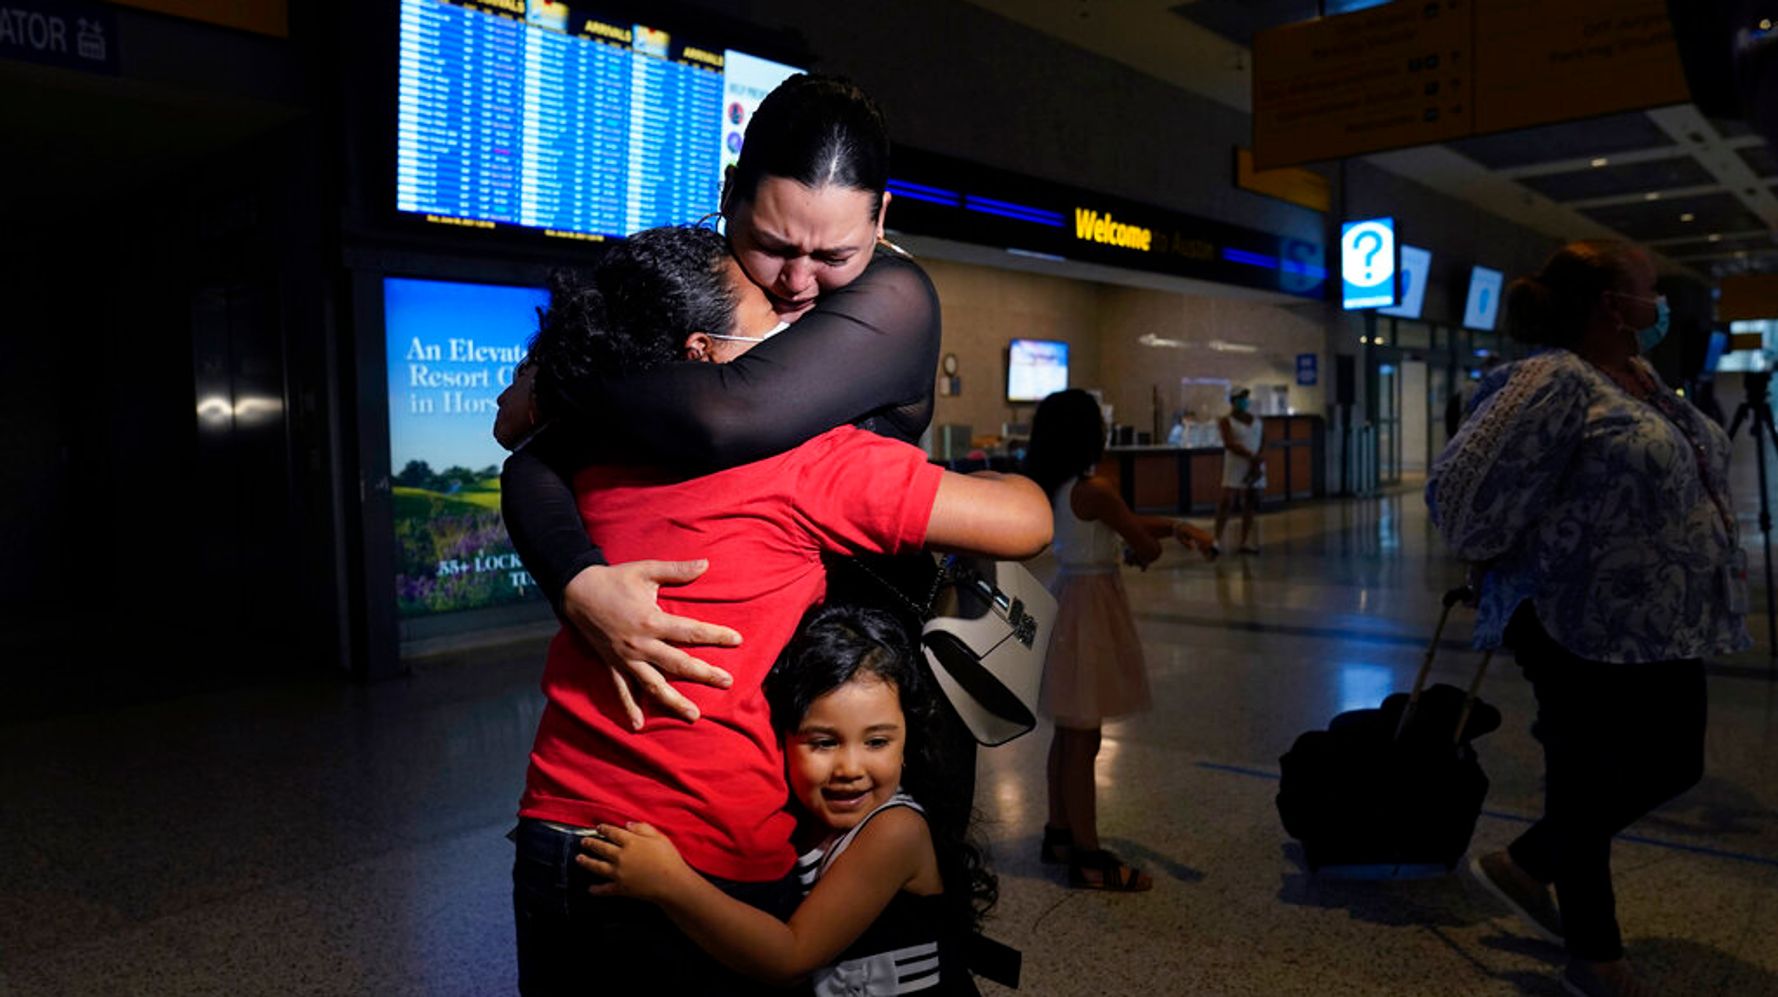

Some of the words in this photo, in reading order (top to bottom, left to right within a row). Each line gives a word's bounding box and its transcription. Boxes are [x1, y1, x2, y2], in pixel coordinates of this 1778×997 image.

[0, 7, 67, 53] ATOR
[1075, 206, 1152, 251] Welcome
[406, 336, 442, 361] An
[410, 363, 490, 388] Resort
[411, 393, 434, 413] in
